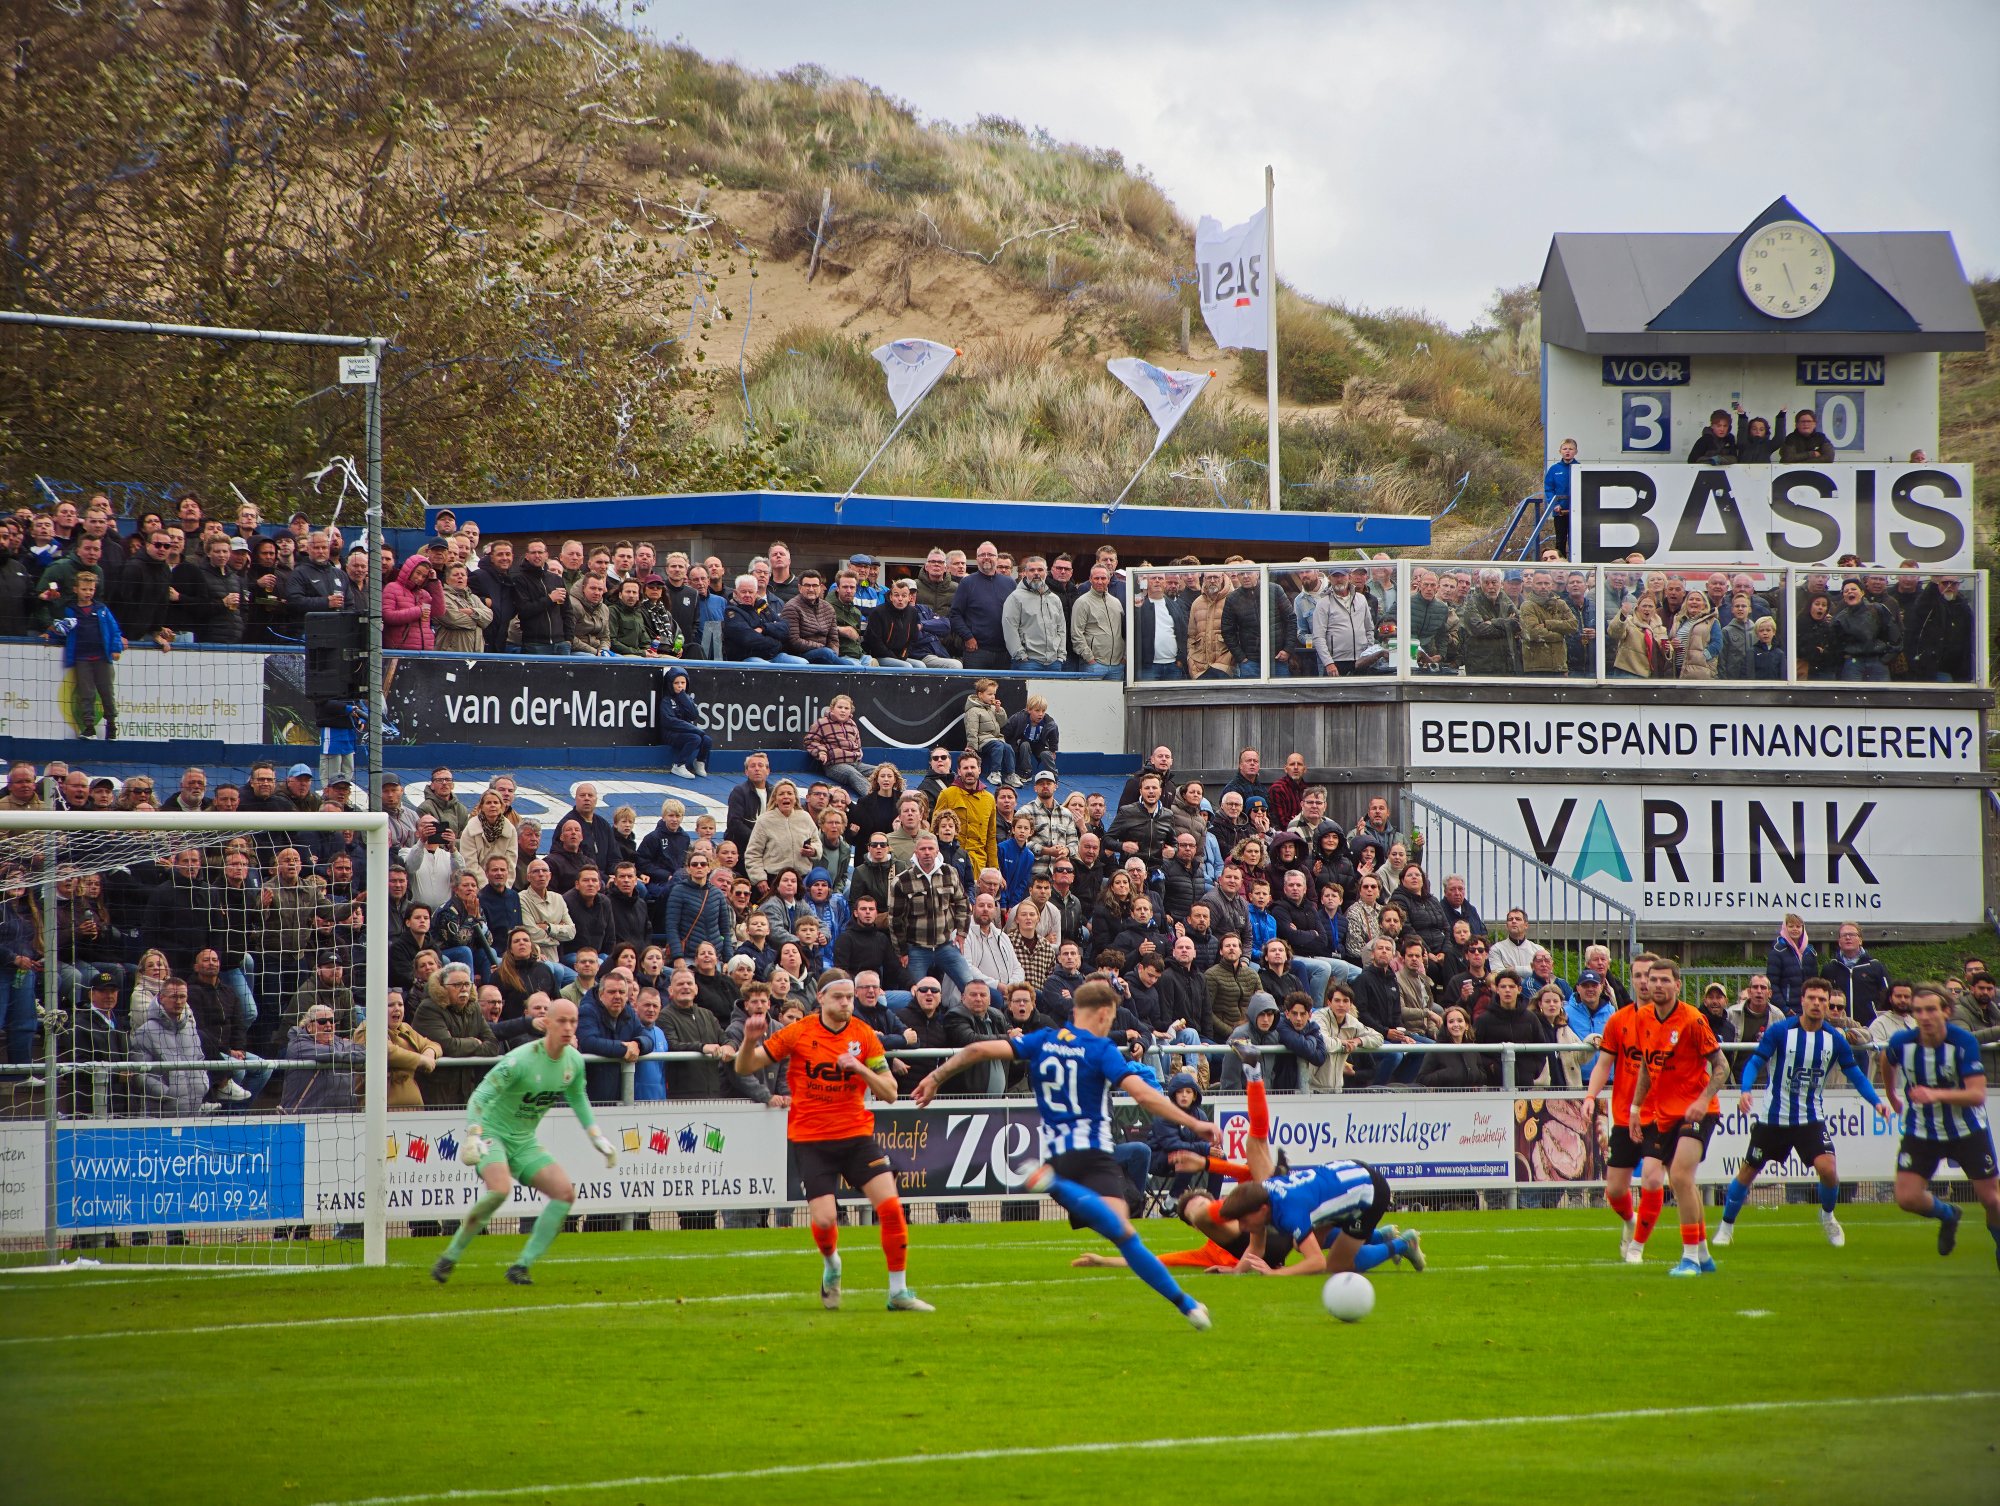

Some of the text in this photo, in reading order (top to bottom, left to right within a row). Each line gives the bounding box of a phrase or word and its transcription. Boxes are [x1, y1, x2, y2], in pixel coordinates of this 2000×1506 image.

[1611, 361, 1683, 381] VOOR
[1802, 360, 1882, 382] TEGEN
[1629, 396, 1663, 449] 3
[1821, 394, 1858, 449] 0
[1580, 469, 1965, 563] BASIS
[164, 703, 185, 715] van
[190, 697, 208, 716] der
[213, 698, 237, 716] Plas
[445, 693, 500, 724] van
[511, 687, 564, 727] der
[572, 689, 656, 729] Marel
[115, 721, 216, 739] OVENIERSBEDRIJF
[1422, 720, 1973, 760] BEDRIJFSPAND FINANCIEREN?
[1517, 797, 1881, 884] VARINK
[1644, 891, 1882, 910] BEDRIJFSFINANCIERING
[1039, 1056, 1082, 1115] 21
[1228, 1130, 1248, 1160] K
[1345, 1112, 1451, 1151] keurslager
[71, 1146, 270, 1184] www.bjverhuur.nl
[619, 1160, 725, 1177] schildersbedrijf
[386, 1190, 413, 1208] AN
[421, 1188, 454, 1206] DER
[513, 1185, 542, 1202] B.V.
[620, 1180, 655, 1198] VAN
[662, 1179, 694, 1197] DER
[701, 1178, 742, 1196] PLAS
[749, 1177, 776, 1195] B.V.
[71, 1194, 132, 1221] Katwijk
[154, 1192, 181, 1214] 071
[189, 1191, 215, 1213] 401
[223, 1190, 243, 1212] 99
[248, 1189, 268, 1211] 24
